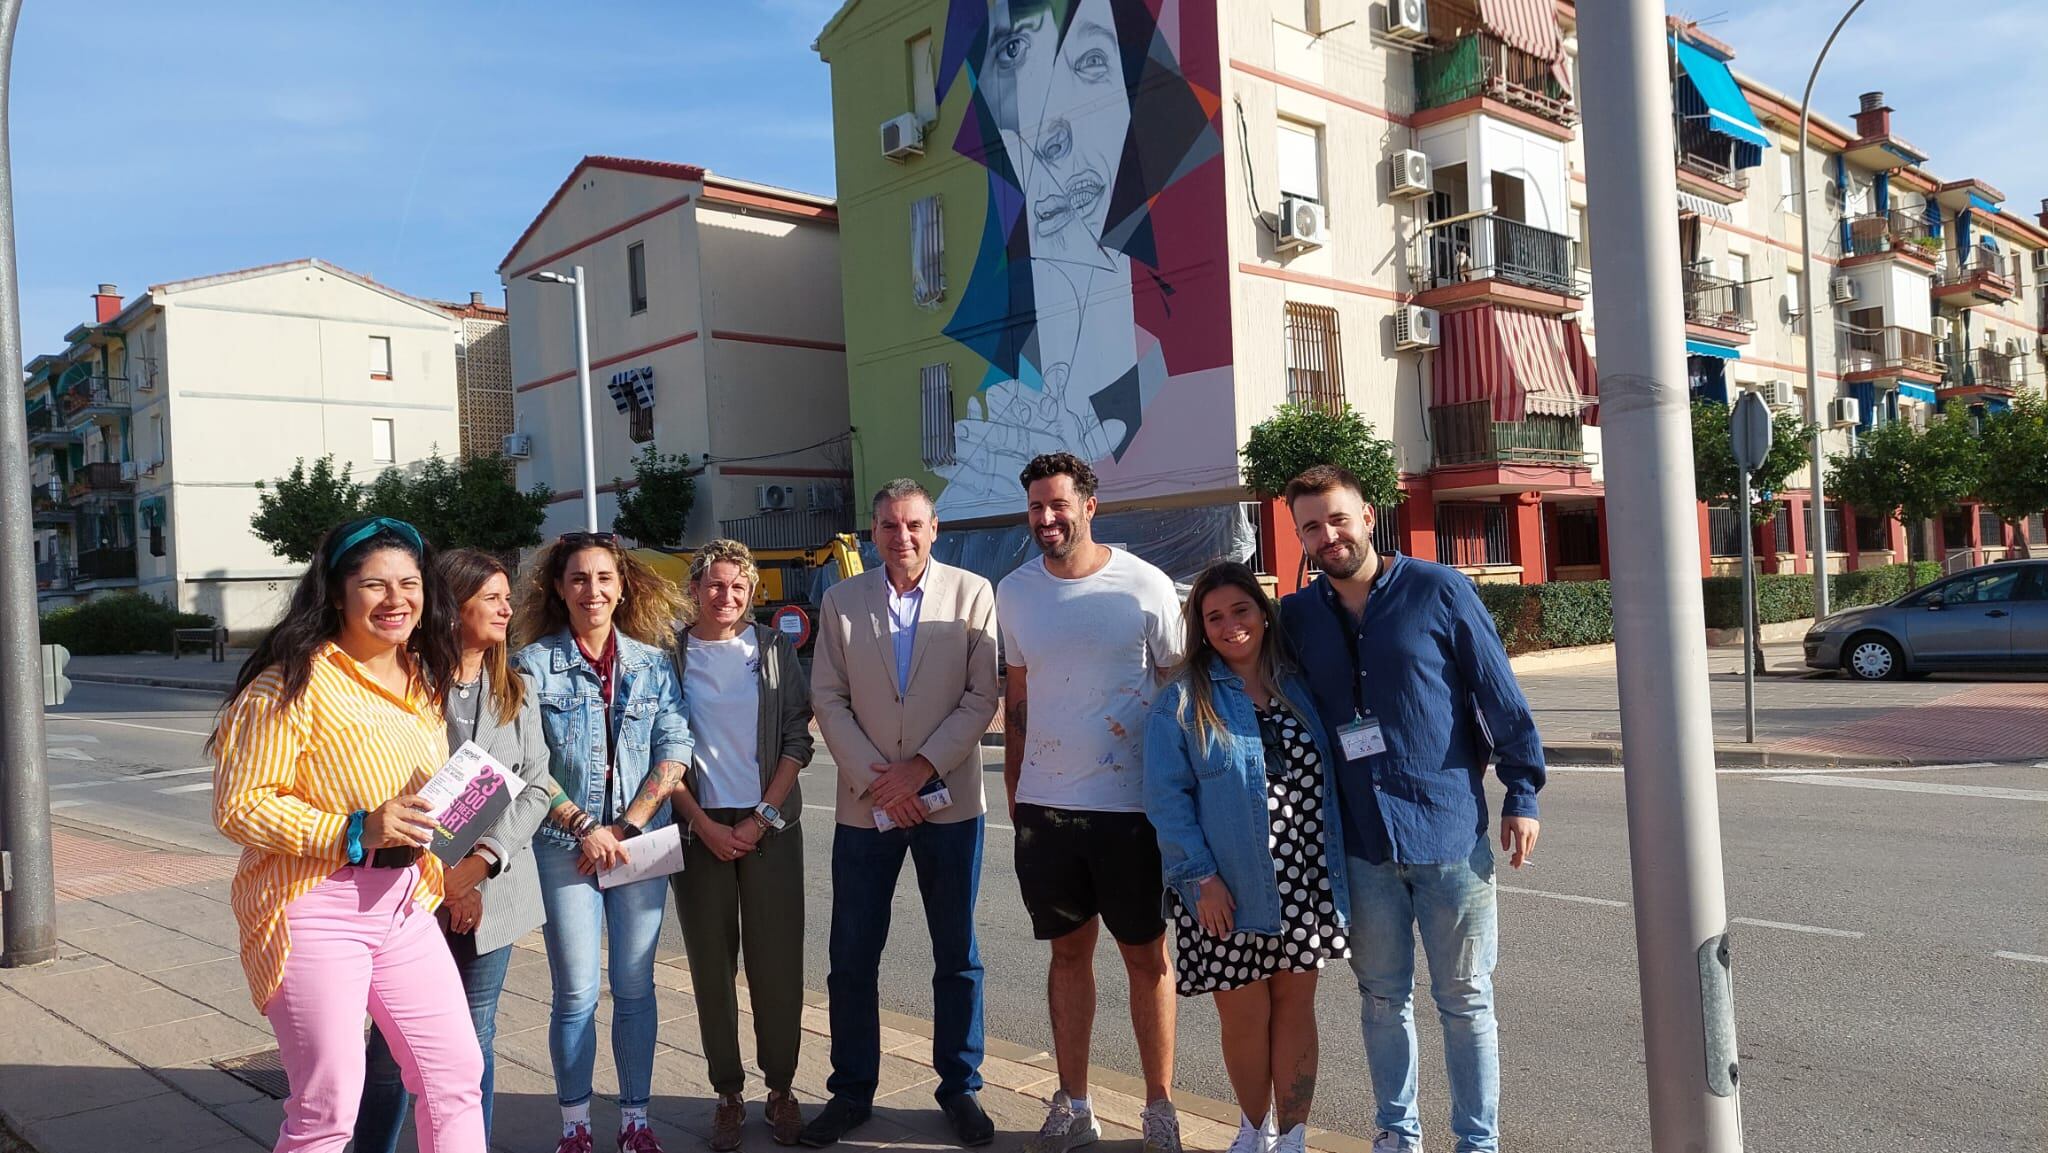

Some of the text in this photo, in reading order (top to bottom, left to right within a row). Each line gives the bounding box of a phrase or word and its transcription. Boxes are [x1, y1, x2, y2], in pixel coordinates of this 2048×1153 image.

[469, 764, 505, 797] 23
[436, 807, 469, 833] ART
[450, 798, 477, 820] STREET
